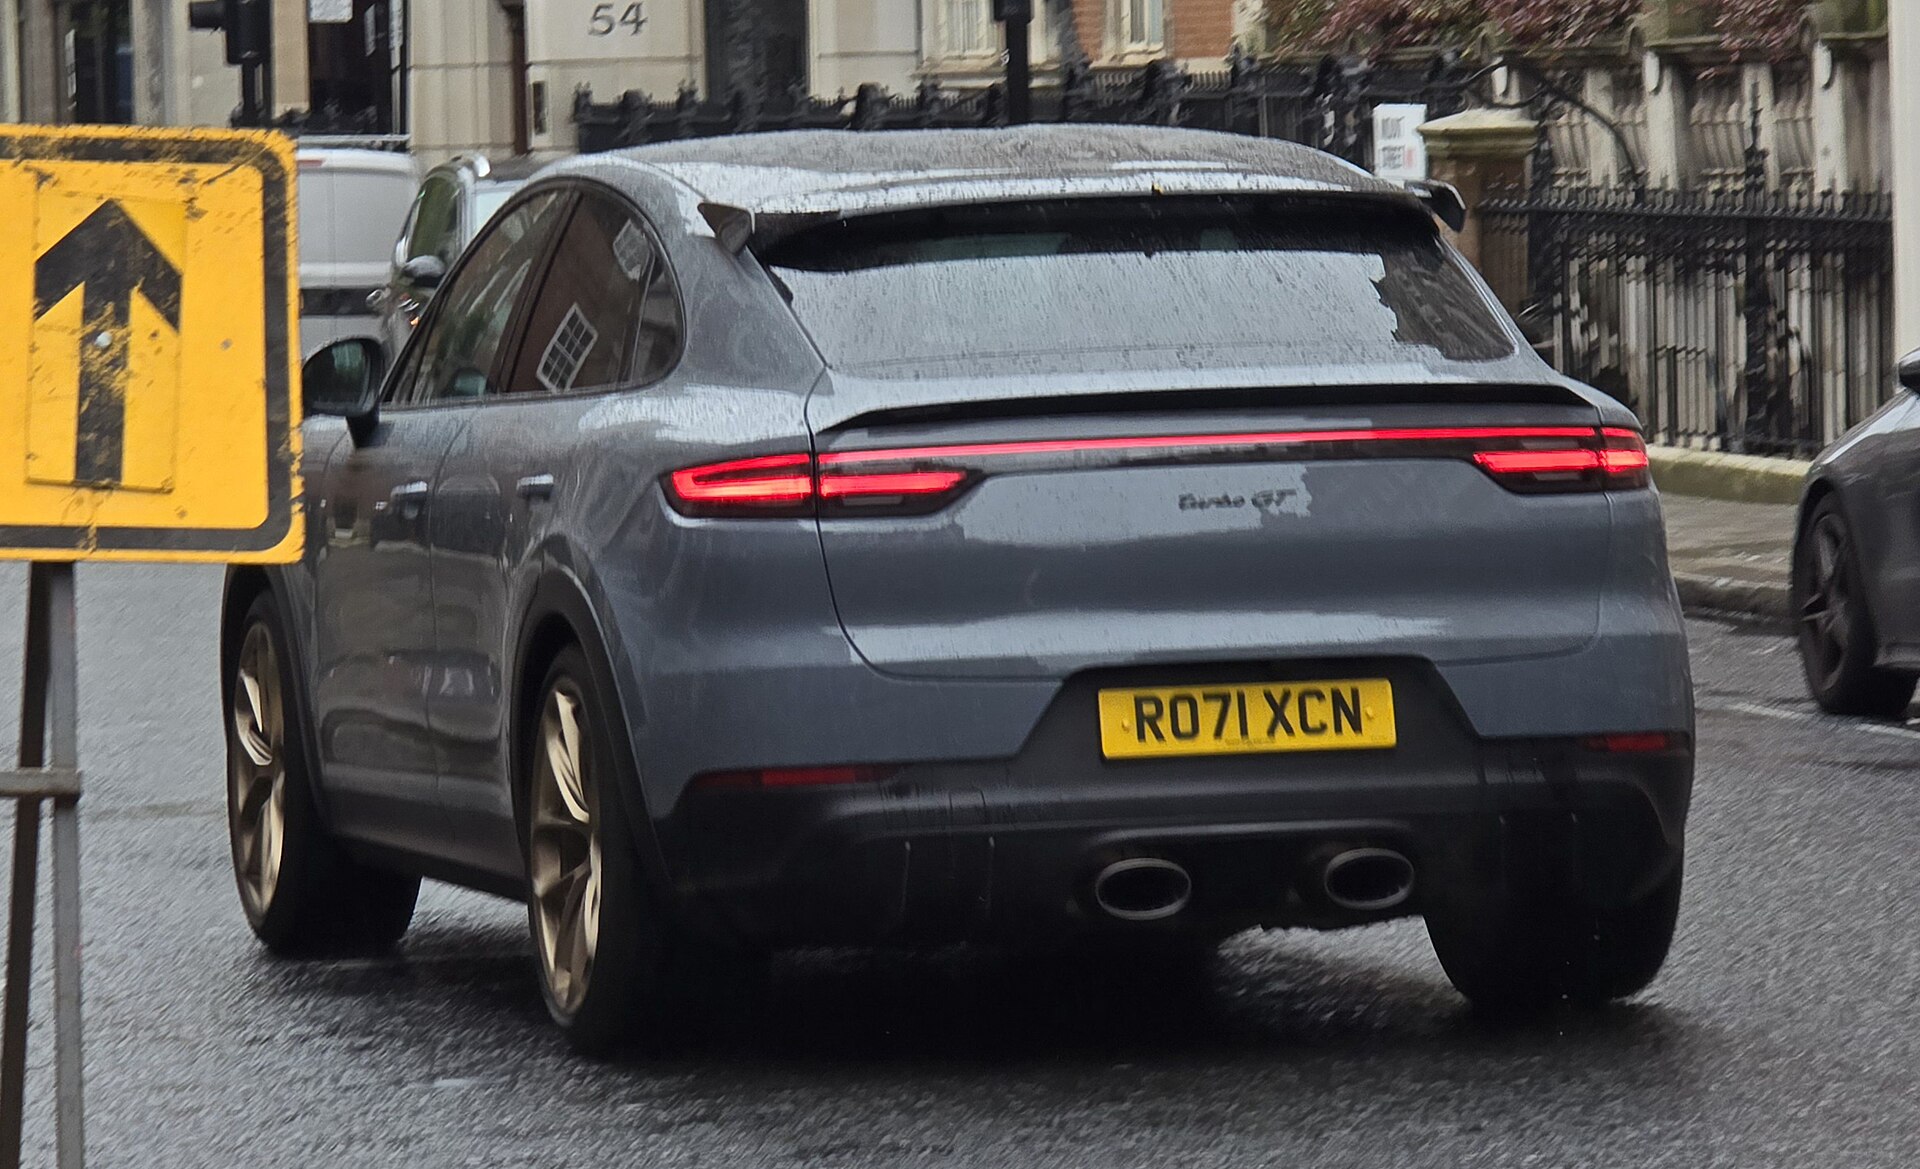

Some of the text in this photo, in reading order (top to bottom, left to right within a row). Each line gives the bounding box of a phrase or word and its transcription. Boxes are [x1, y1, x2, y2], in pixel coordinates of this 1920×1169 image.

[588, 2, 648, 37] 54
[1179, 489, 1297, 512] Turbo GT
[1263, 686, 1364, 739] XCN
